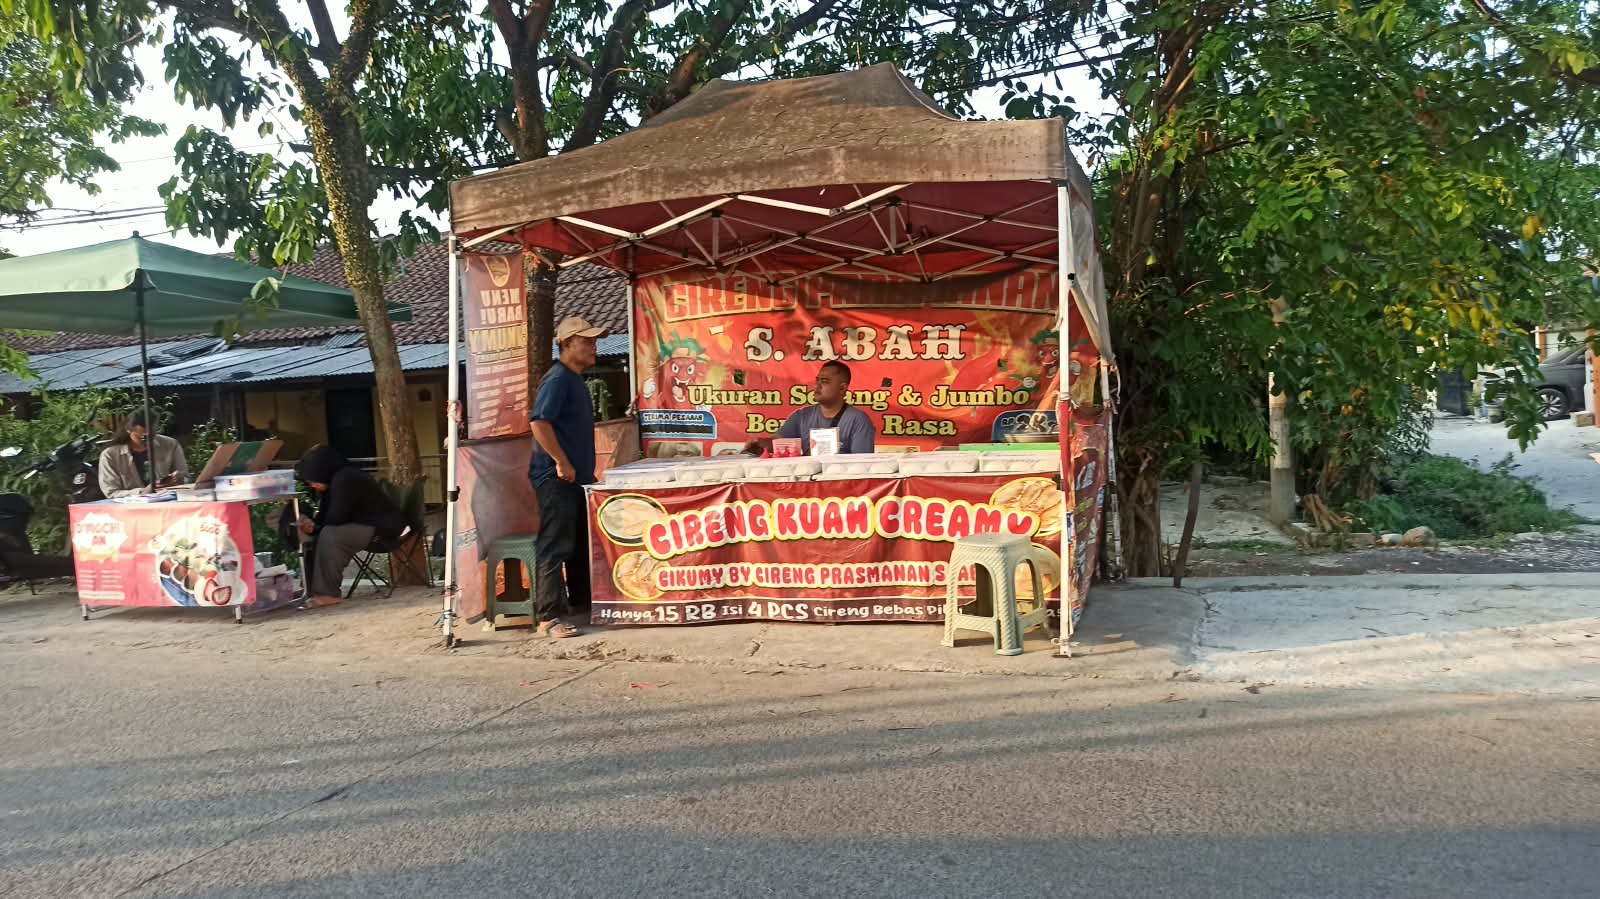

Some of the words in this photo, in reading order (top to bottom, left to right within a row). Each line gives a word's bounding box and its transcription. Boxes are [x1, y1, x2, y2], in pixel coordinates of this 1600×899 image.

[744, 326, 786, 362] S.
[801, 324, 967, 362] ABAH
[687, 384, 782, 406] Ukuran
[790, 385, 892, 412] Seang
[897, 385, 923, 406] &
[930, 385, 1031, 409] Jumbo
[882, 415, 957, 436] Rasa
[648, 502, 770, 557] CIRENG
[775, 499, 869, 538] KUAH
[658, 566, 724, 588] CIKUMY
[728, 565, 751, 584] BY
[755, 566, 816, 585] CIRENG
[820, 563, 931, 585] PRASMANAN
[600, 609, 652, 621] Hanya
[654, 605, 680, 622] 15
[685, 603, 717, 621] RB
[721, 605, 743, 616] Isi
[747, 601, 762, 618] 4
[767, 601, 809, 620] PCS
[813, 605, 870, 618] Cireng
[872, 604, 924, 616] Bebas
